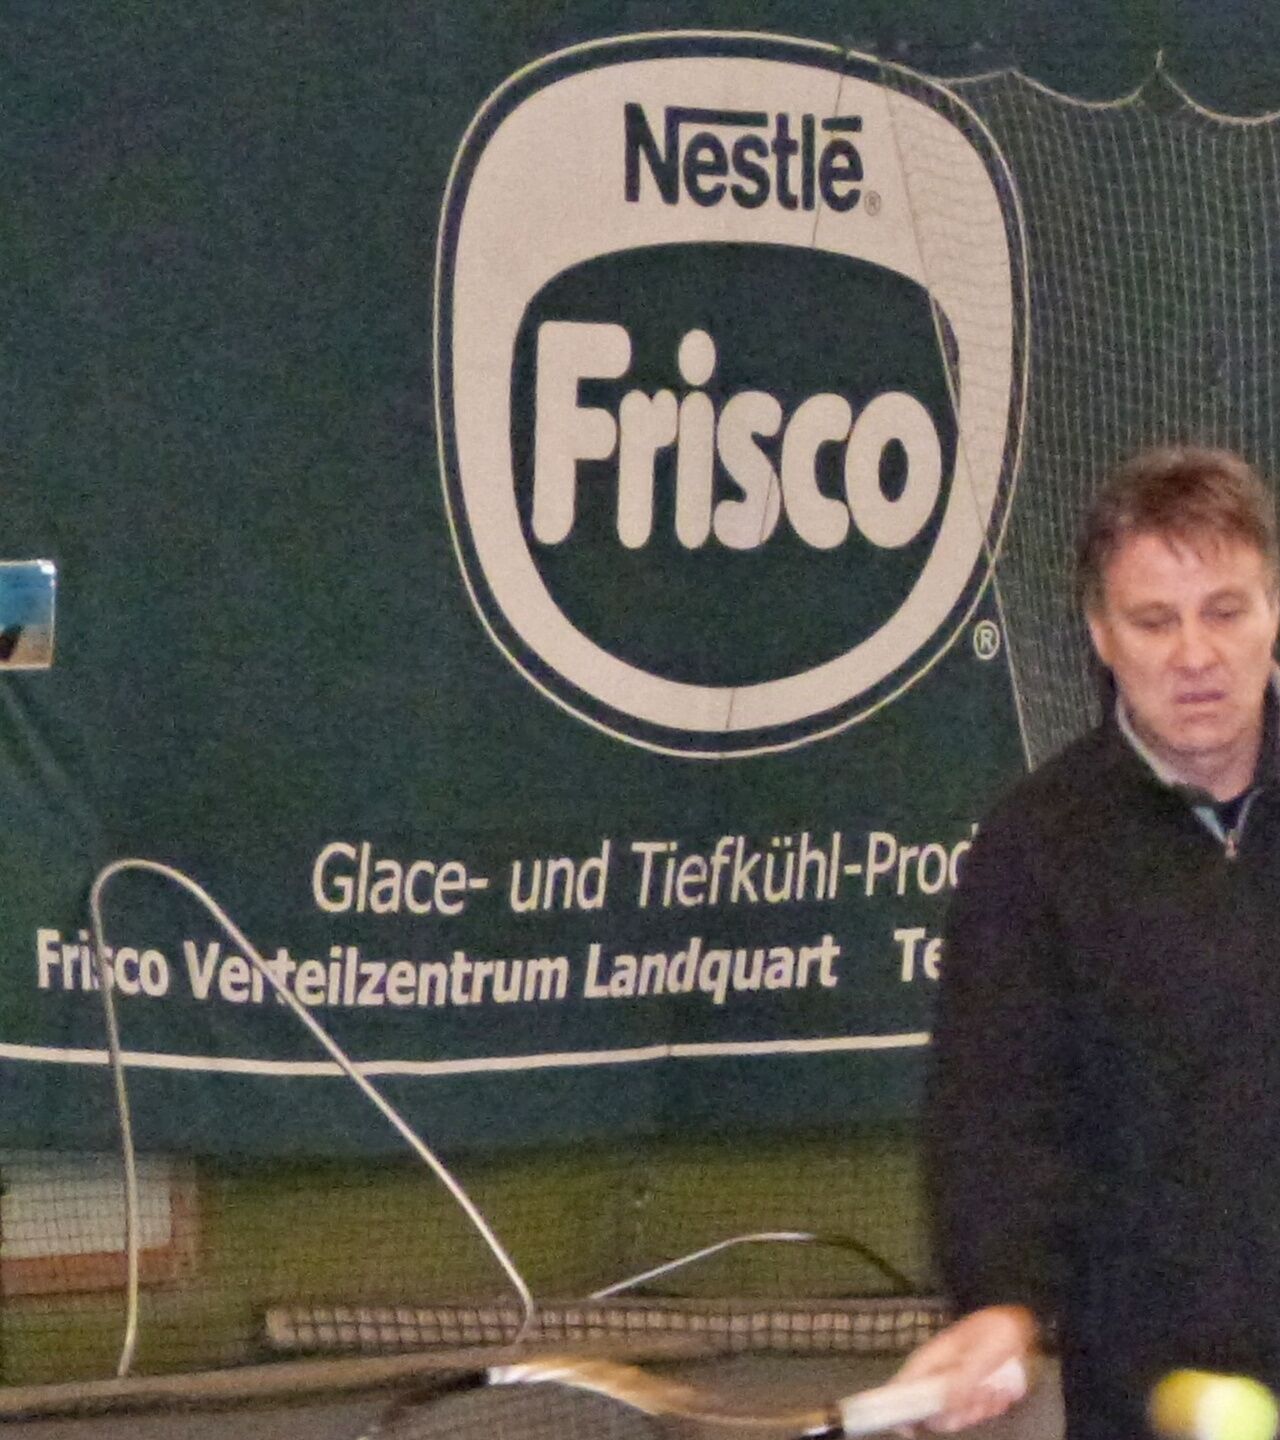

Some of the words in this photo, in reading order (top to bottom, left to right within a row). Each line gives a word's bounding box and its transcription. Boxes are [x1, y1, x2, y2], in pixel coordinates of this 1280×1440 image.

[624, 102, 864, 212] Nestlé
[531, 320, 942, 550] Frisco
[312, 842, 489, 914] Glace-
[509, 837, 606, 913] und
[36, 929, 169, 998] Frisco
[183, 939, 568, 1007] Verteilzentrum
[584, 933, 841, 1005] Landquart
